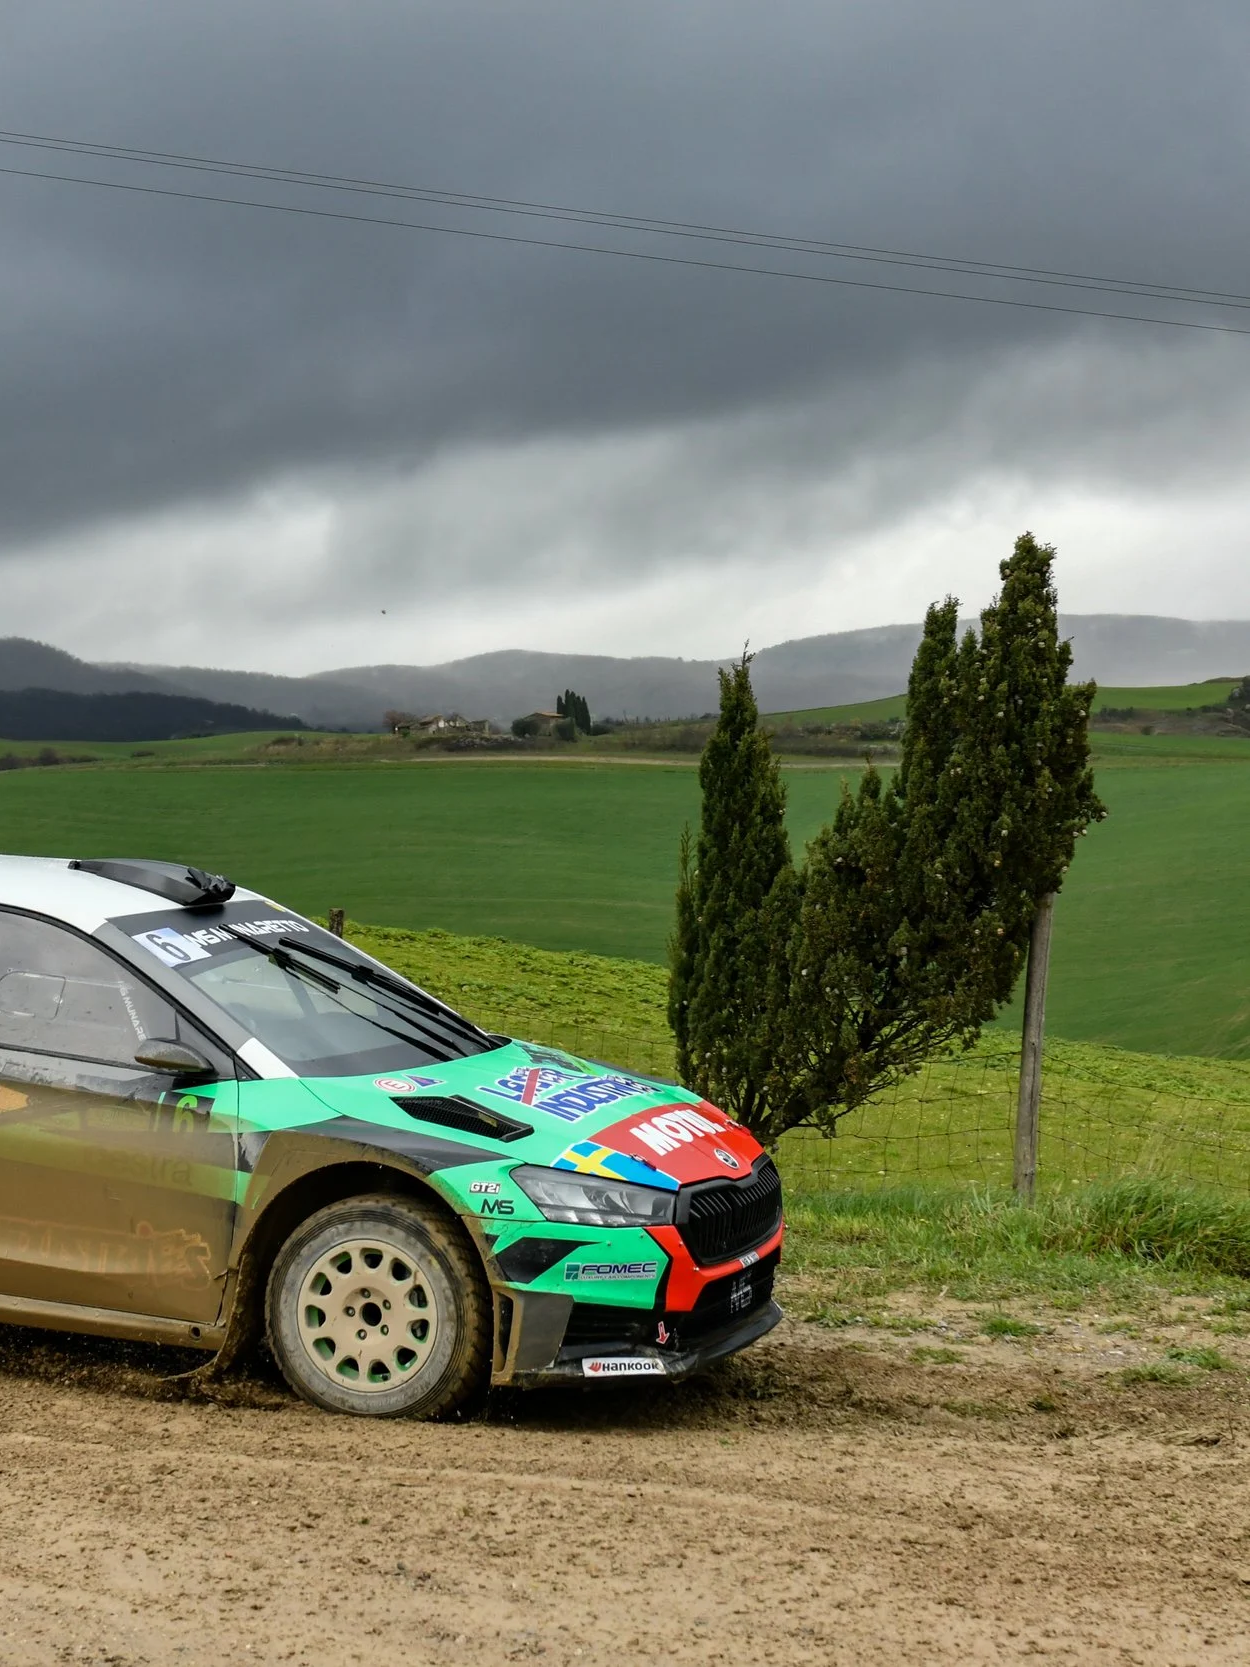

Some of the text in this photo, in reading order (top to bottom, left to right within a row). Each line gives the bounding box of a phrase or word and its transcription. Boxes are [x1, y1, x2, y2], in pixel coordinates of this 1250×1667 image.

[146, 933, 192, 962] 6
[630, 1108, 727, 1157] MOTUL
[480, 1199, 515, 1215] MS
[581, 1262, 657, 1275] FOMEC
